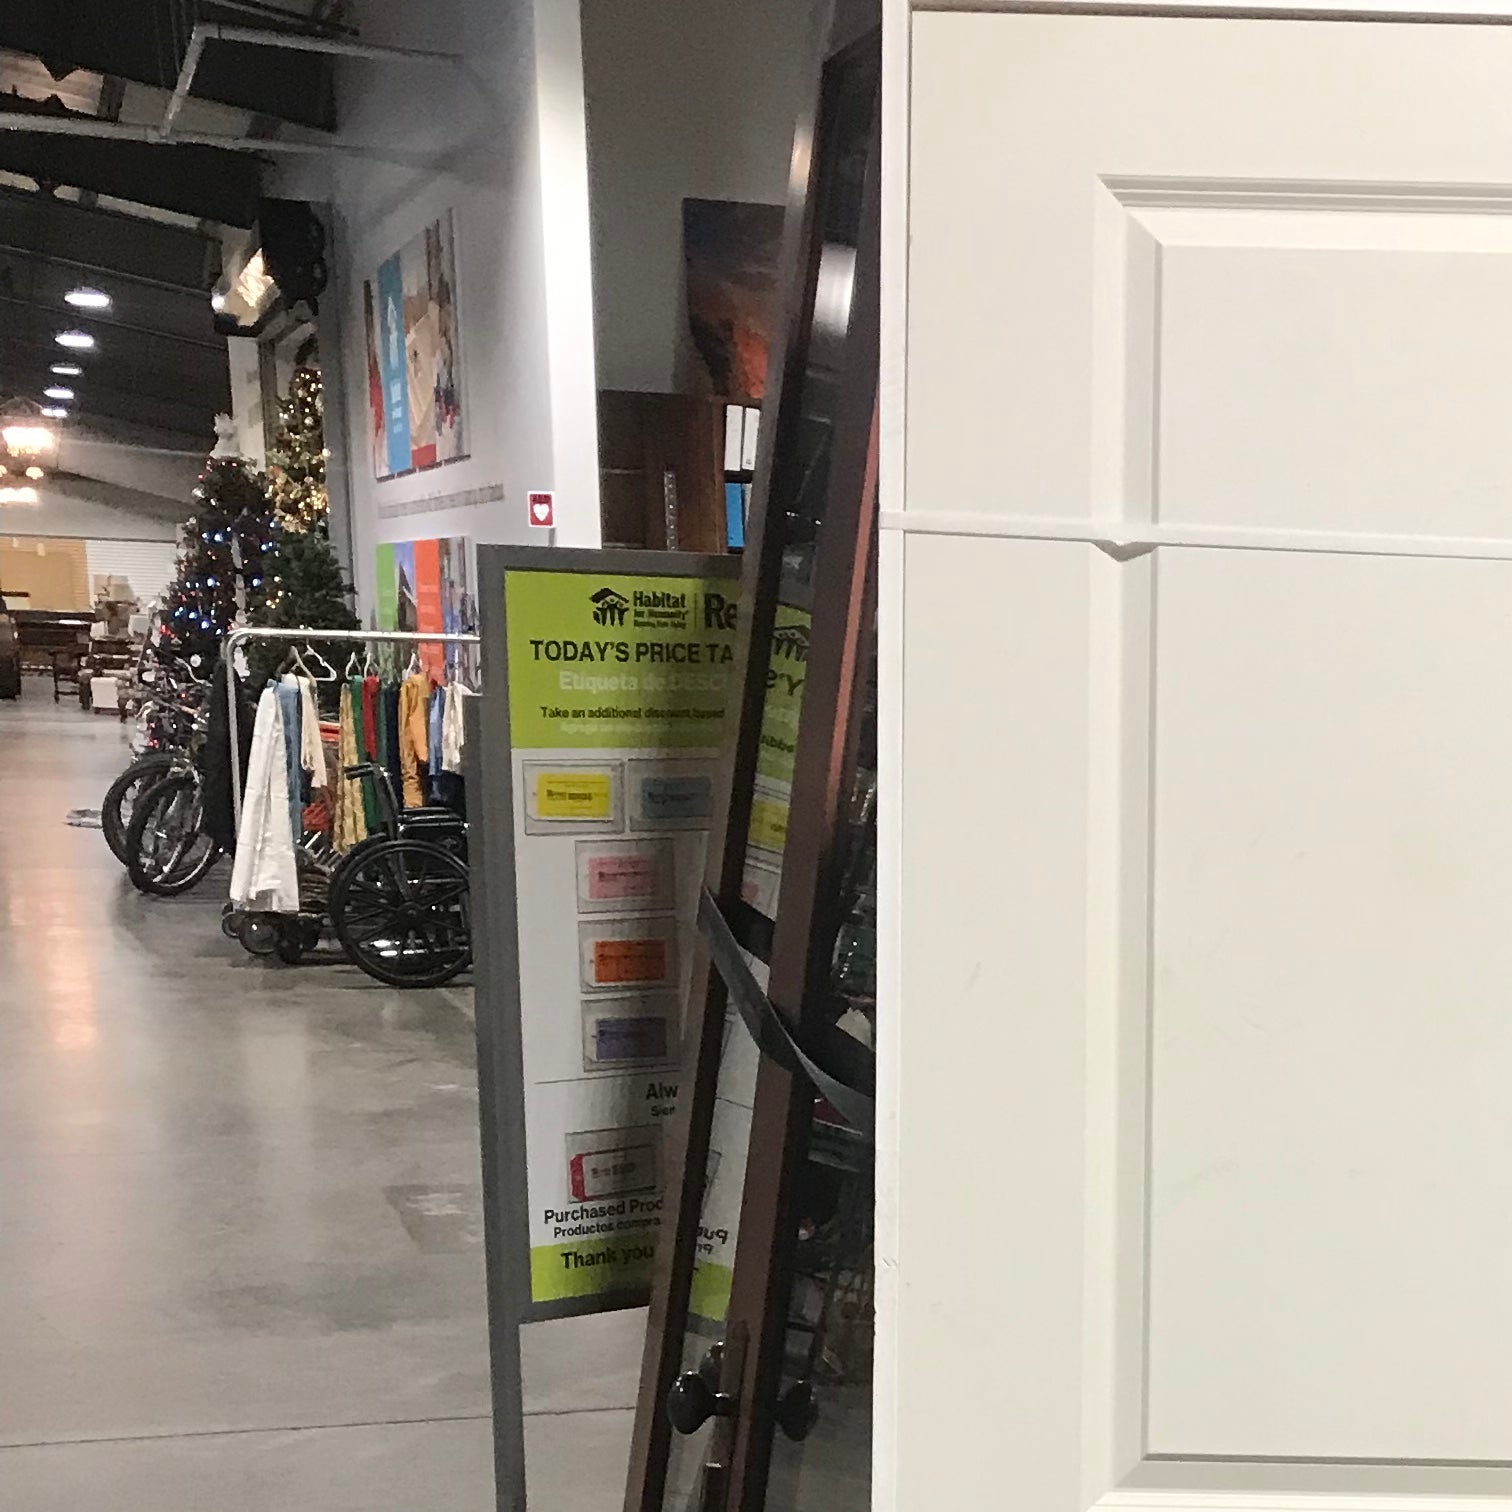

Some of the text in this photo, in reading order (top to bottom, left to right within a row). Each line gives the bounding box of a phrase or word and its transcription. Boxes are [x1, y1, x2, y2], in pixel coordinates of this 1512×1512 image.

[633, 590, 686, 609] Habitat
[530, 639, 630, 663] TODAY'S
[635, 642, 701, 664] PRICE
[559, 669, 637, 694] Etiqueta
[540, 706, 569, 718] Take
[571, 709, 585, 718] an
[587, 705, 642, 719] additional
[544, 1200, 626, 1225] Purchased
[554, 1222, 613, 1238] Productos
[560, 1246, 655, 1270] Thank you
